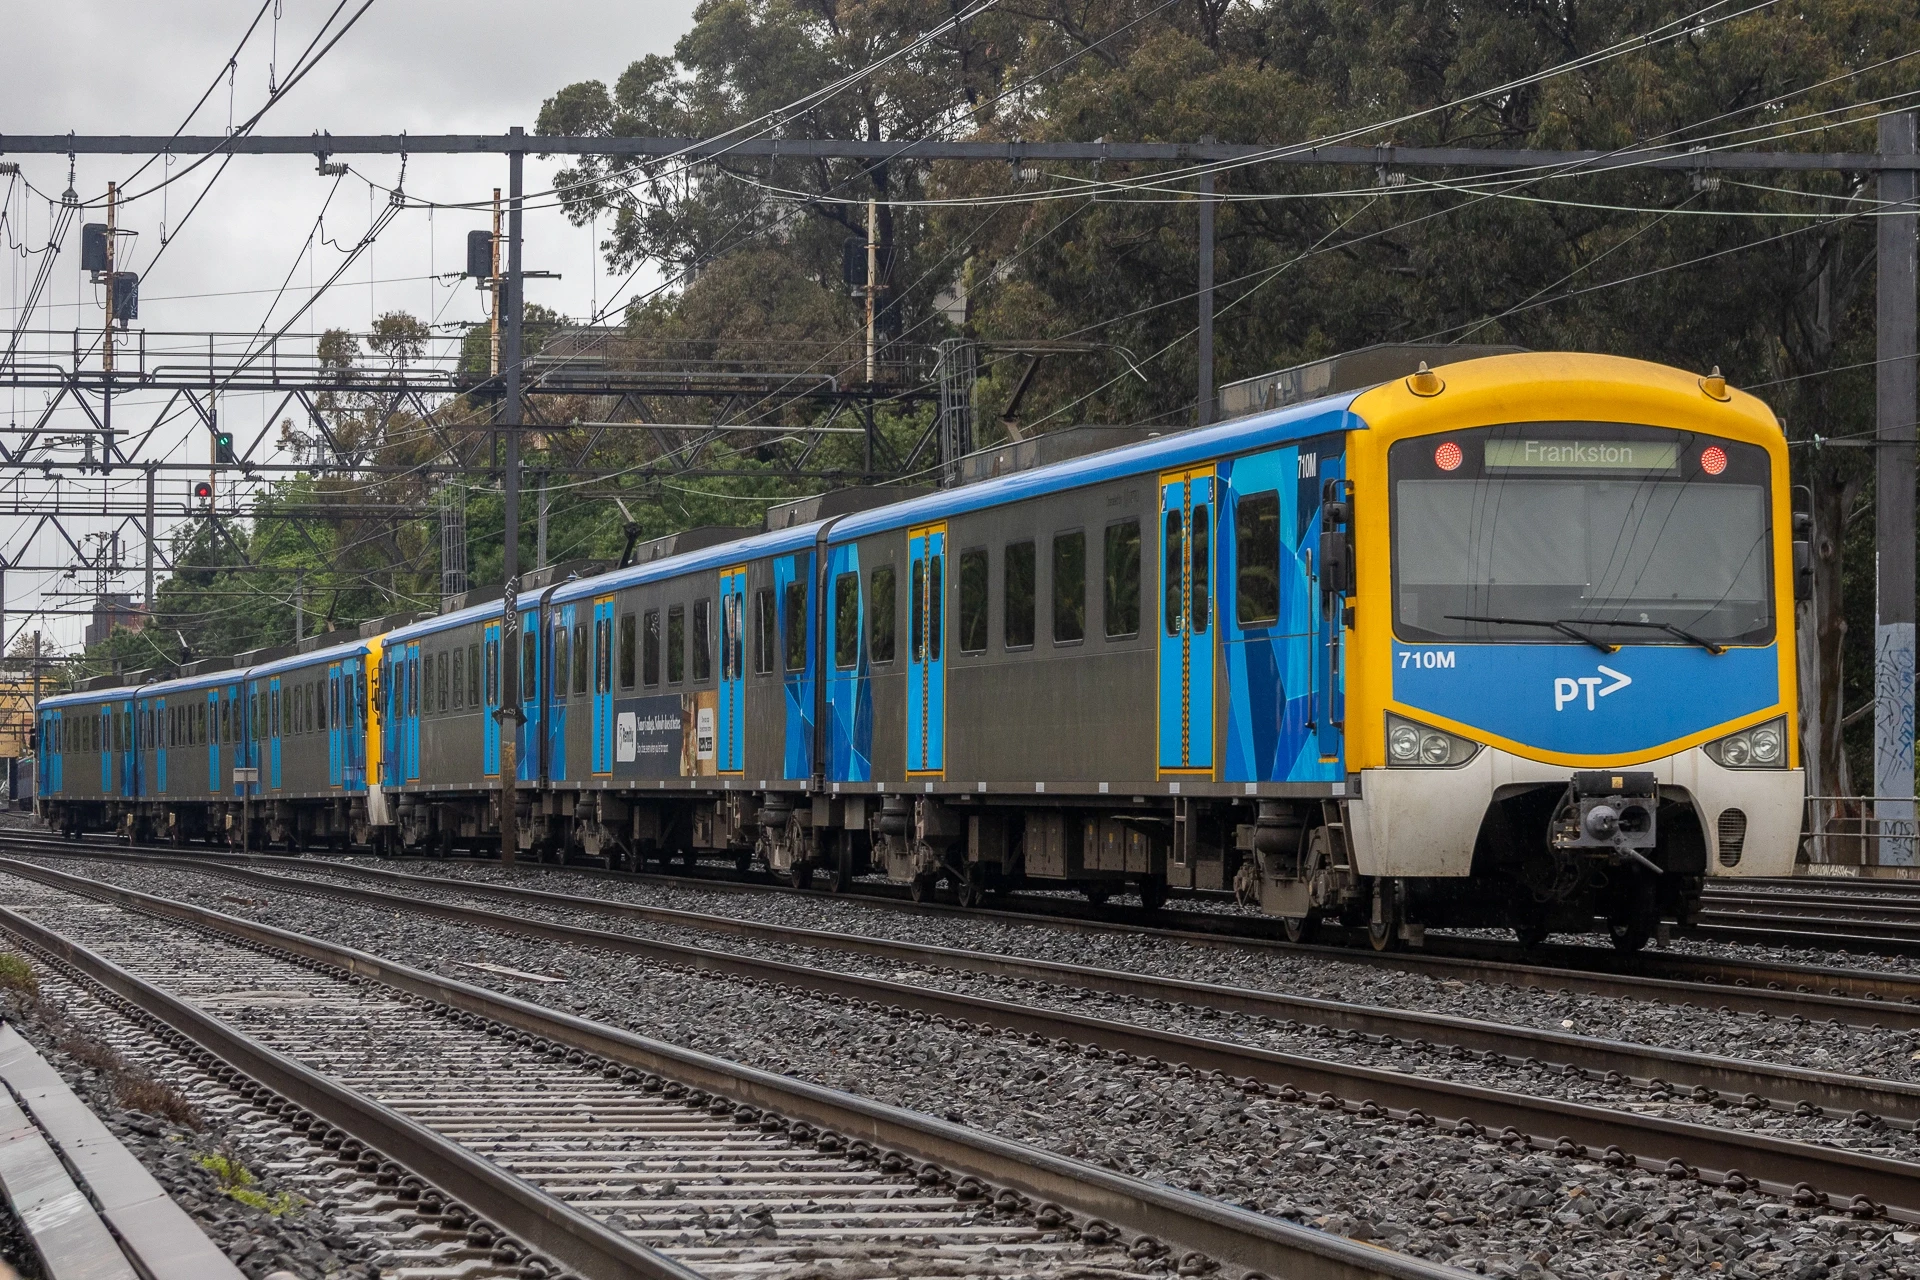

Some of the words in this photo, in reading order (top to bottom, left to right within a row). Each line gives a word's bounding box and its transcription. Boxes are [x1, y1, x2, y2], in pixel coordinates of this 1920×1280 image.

[1525, 441, 1633, 463] Frankston
[1297, 452, 1317, 479] 710M
[1399, 651, 1456, 669] 710M
